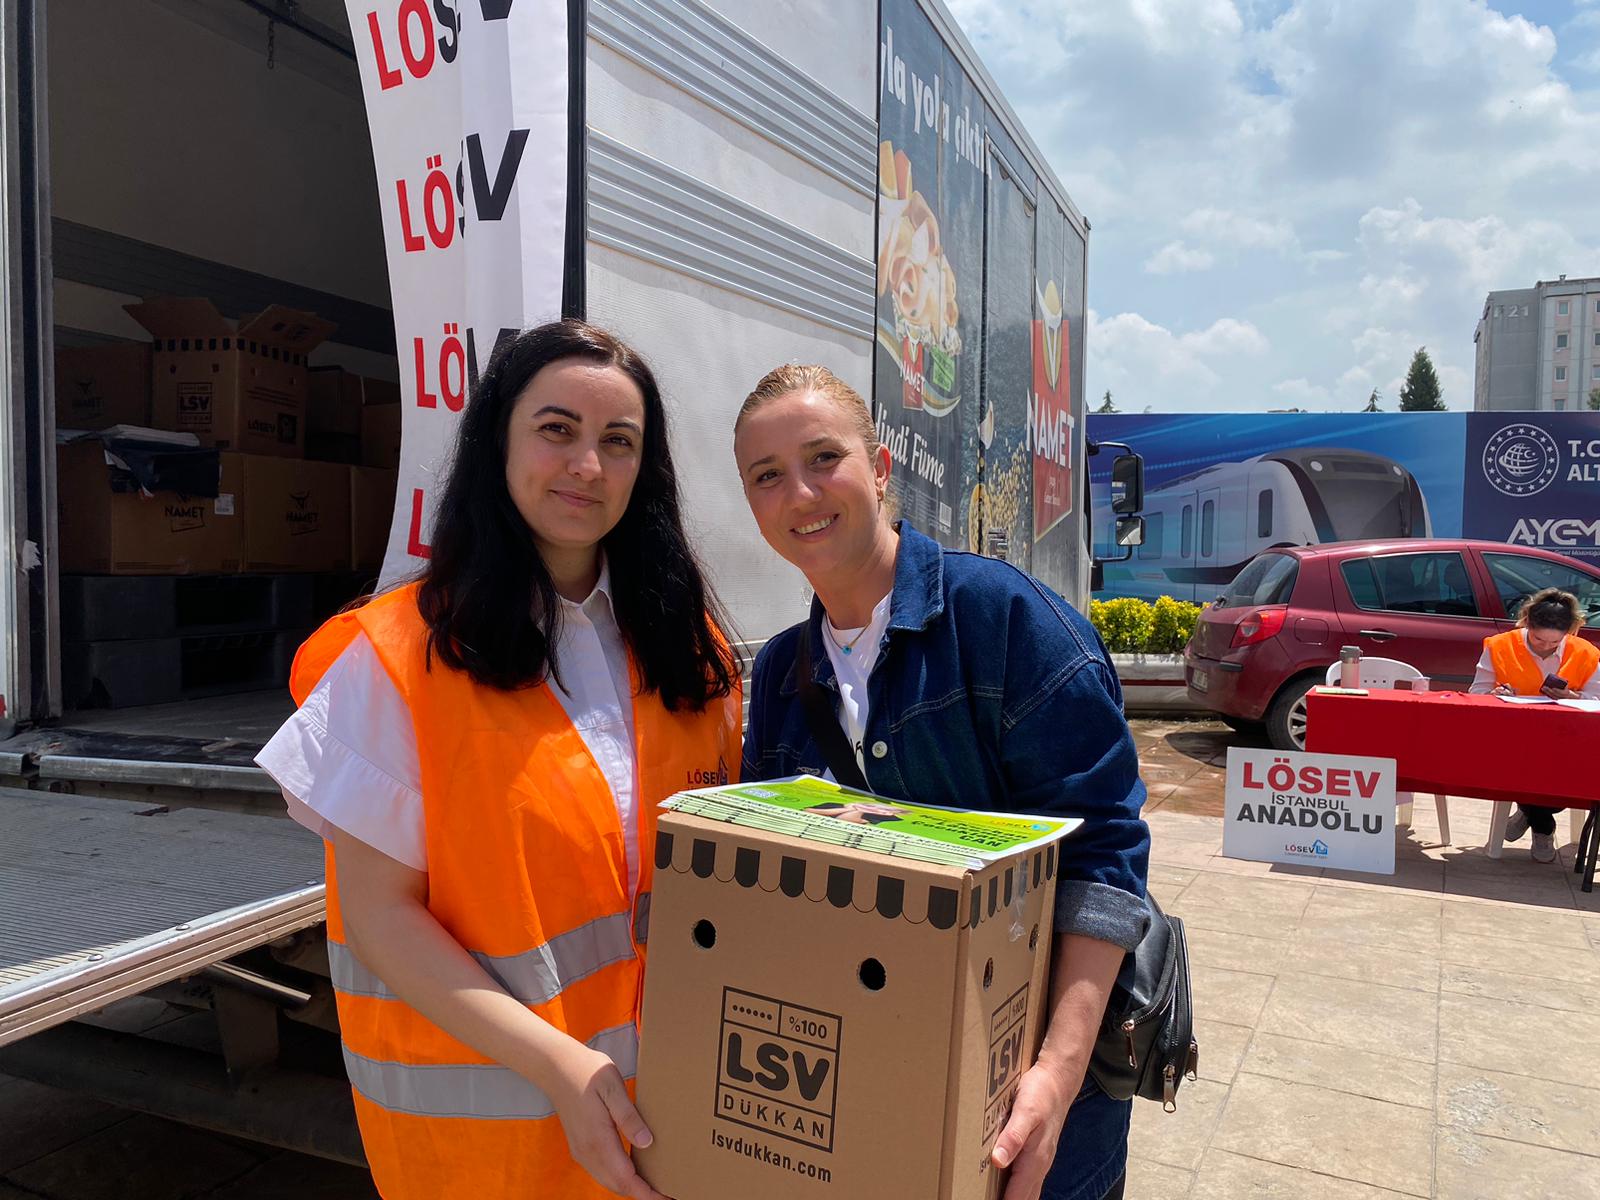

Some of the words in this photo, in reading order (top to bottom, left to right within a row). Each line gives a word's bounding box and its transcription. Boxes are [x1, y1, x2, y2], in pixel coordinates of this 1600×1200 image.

[900, 360, 926, 394] NAMET
[179, 395, 210, 411] LSV
[1027, 388, 1075, 470] NAMET
[911, 432, 944, 488] Füme
[165, 506, 205, 519] NAMET
[286, 511, 318, 523] NAMET
[687, 768, 720, 785] LÖSEV
[1243, 757, 1381, 798] LÖSEV
[1271, 792, 1349, 811] İSTANBUL
[1236, 803, 1383, 834] ANADOLU
[959, 835, 1002, 847] CAN
[1285, 843, 1315, 853] LÖSEV
[789, 1015, 827, 1039] %100
[726, 1032, 830, 1101] LSV
[989, 1025, 1024, 1098] LSV
[723, 1094, 825, 1139] DÜKKAN
[711, 1129, 832, 1183] lsvdukkan.com
